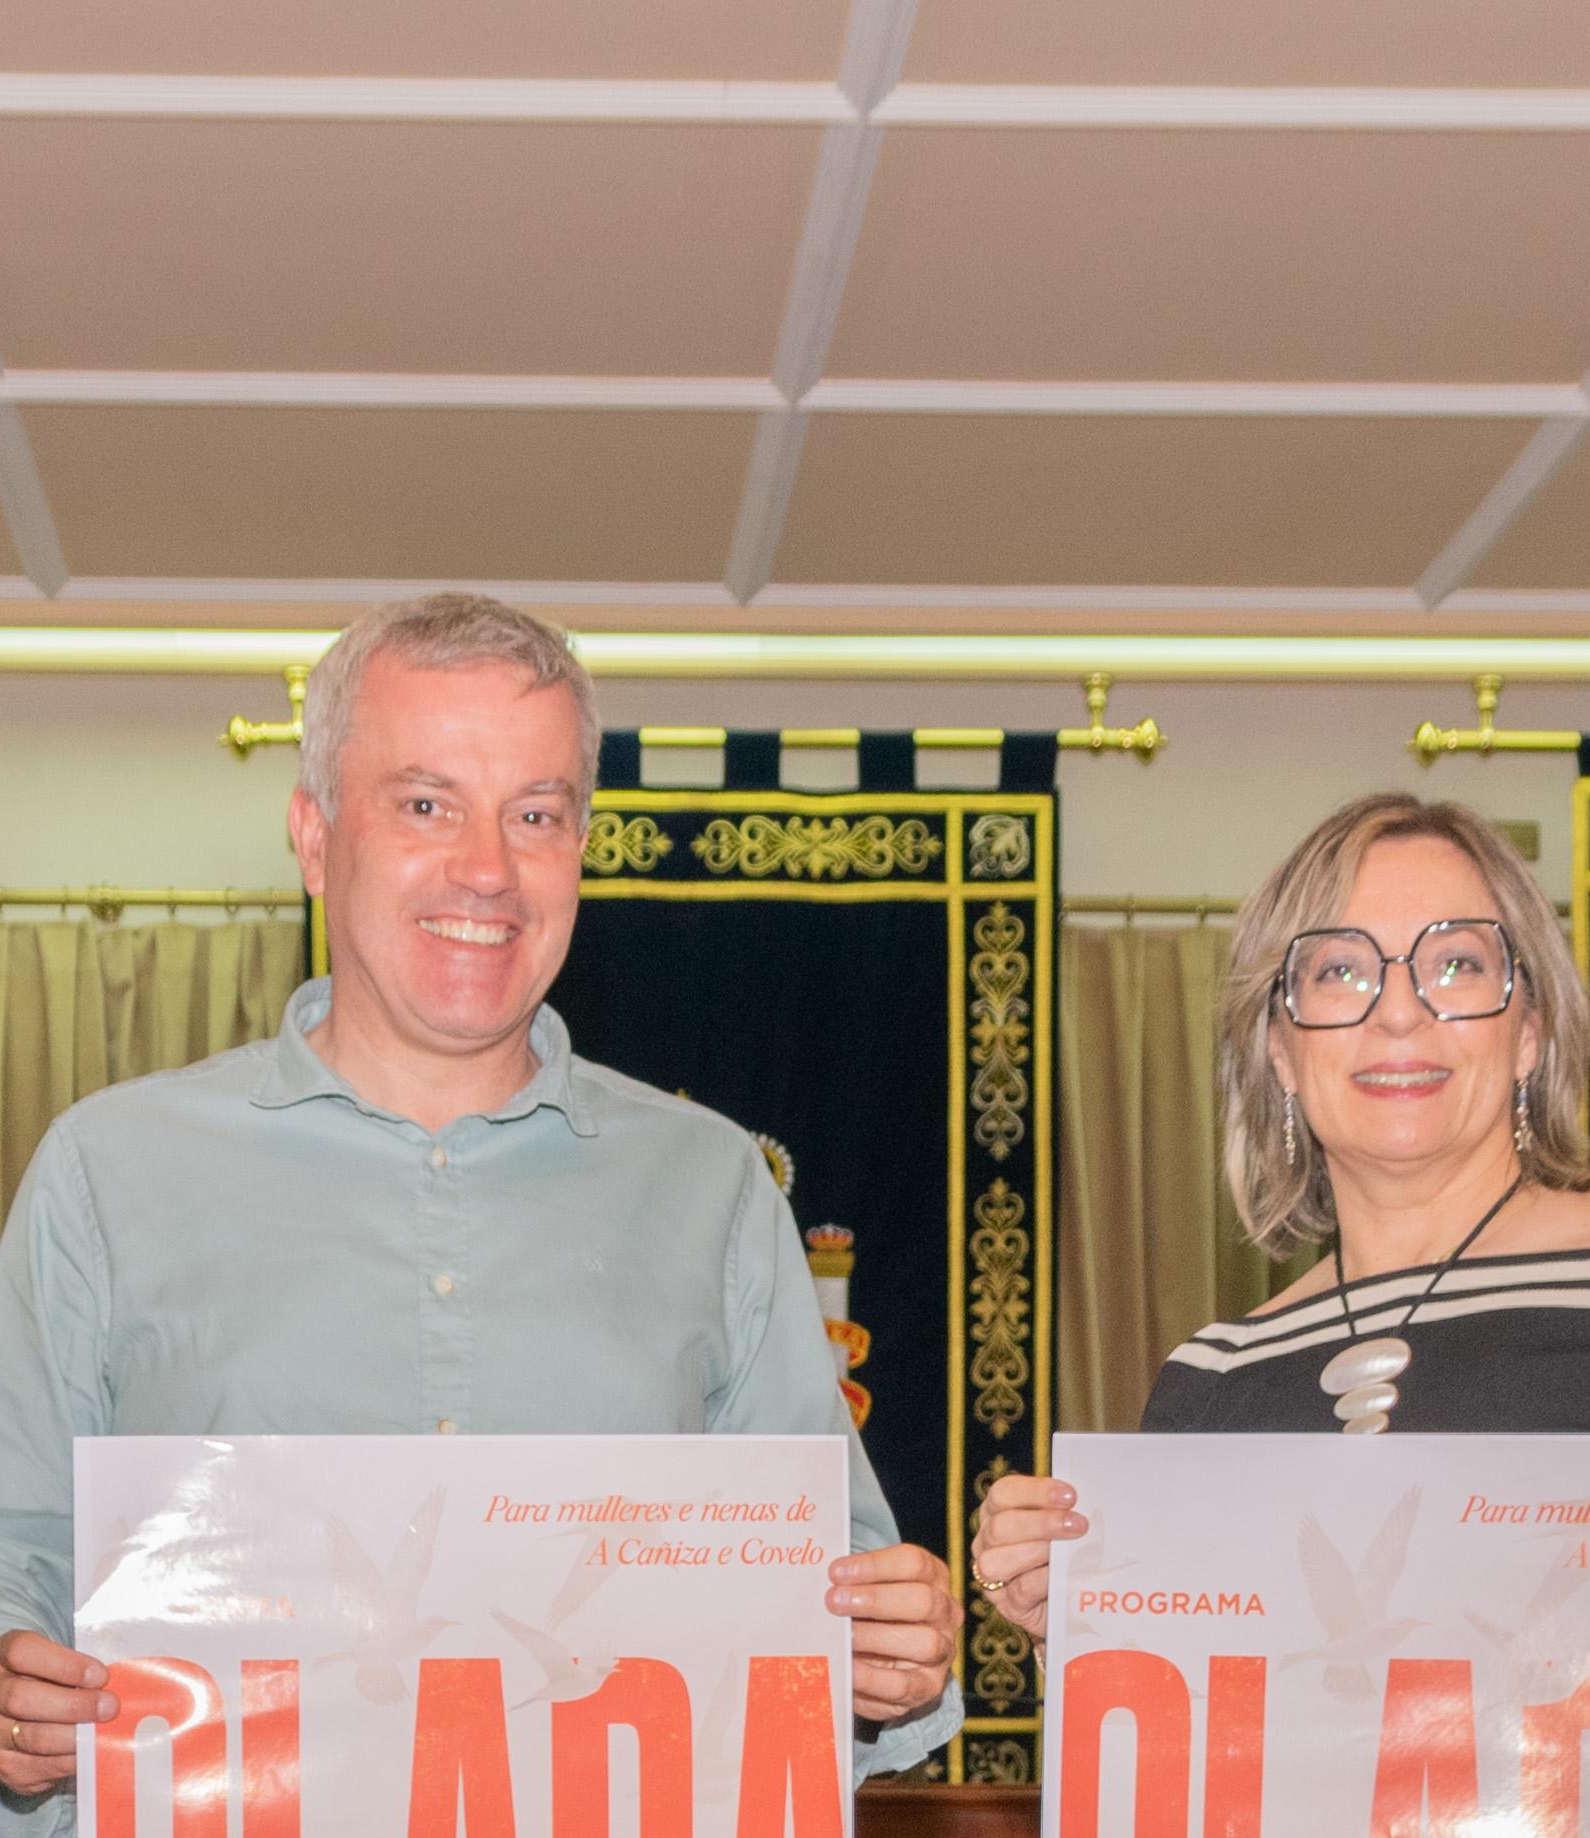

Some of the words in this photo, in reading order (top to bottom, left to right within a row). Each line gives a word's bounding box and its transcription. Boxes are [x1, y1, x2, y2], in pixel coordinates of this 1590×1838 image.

[483, 1494, 550, 1523] Para
[556, 1494, 672, 1523] mulleres
[678, 1502, 694, 1522] e
[700, 1501, 780, 1522] nenas
[786, 1494, 817, 1522] de
[1459, 1495, 1528, 1525] Para
[585, 1537, 609, 1566] A
[617, 1538, 711, 1566] Cañiza
[717, 1545, 733, 1566] e
[740, 1537, 825, 1566] Covelo
[1564, 1539, 1587, 1569] A
[1079, 1590, 1266, 1616] PROGRAMA
